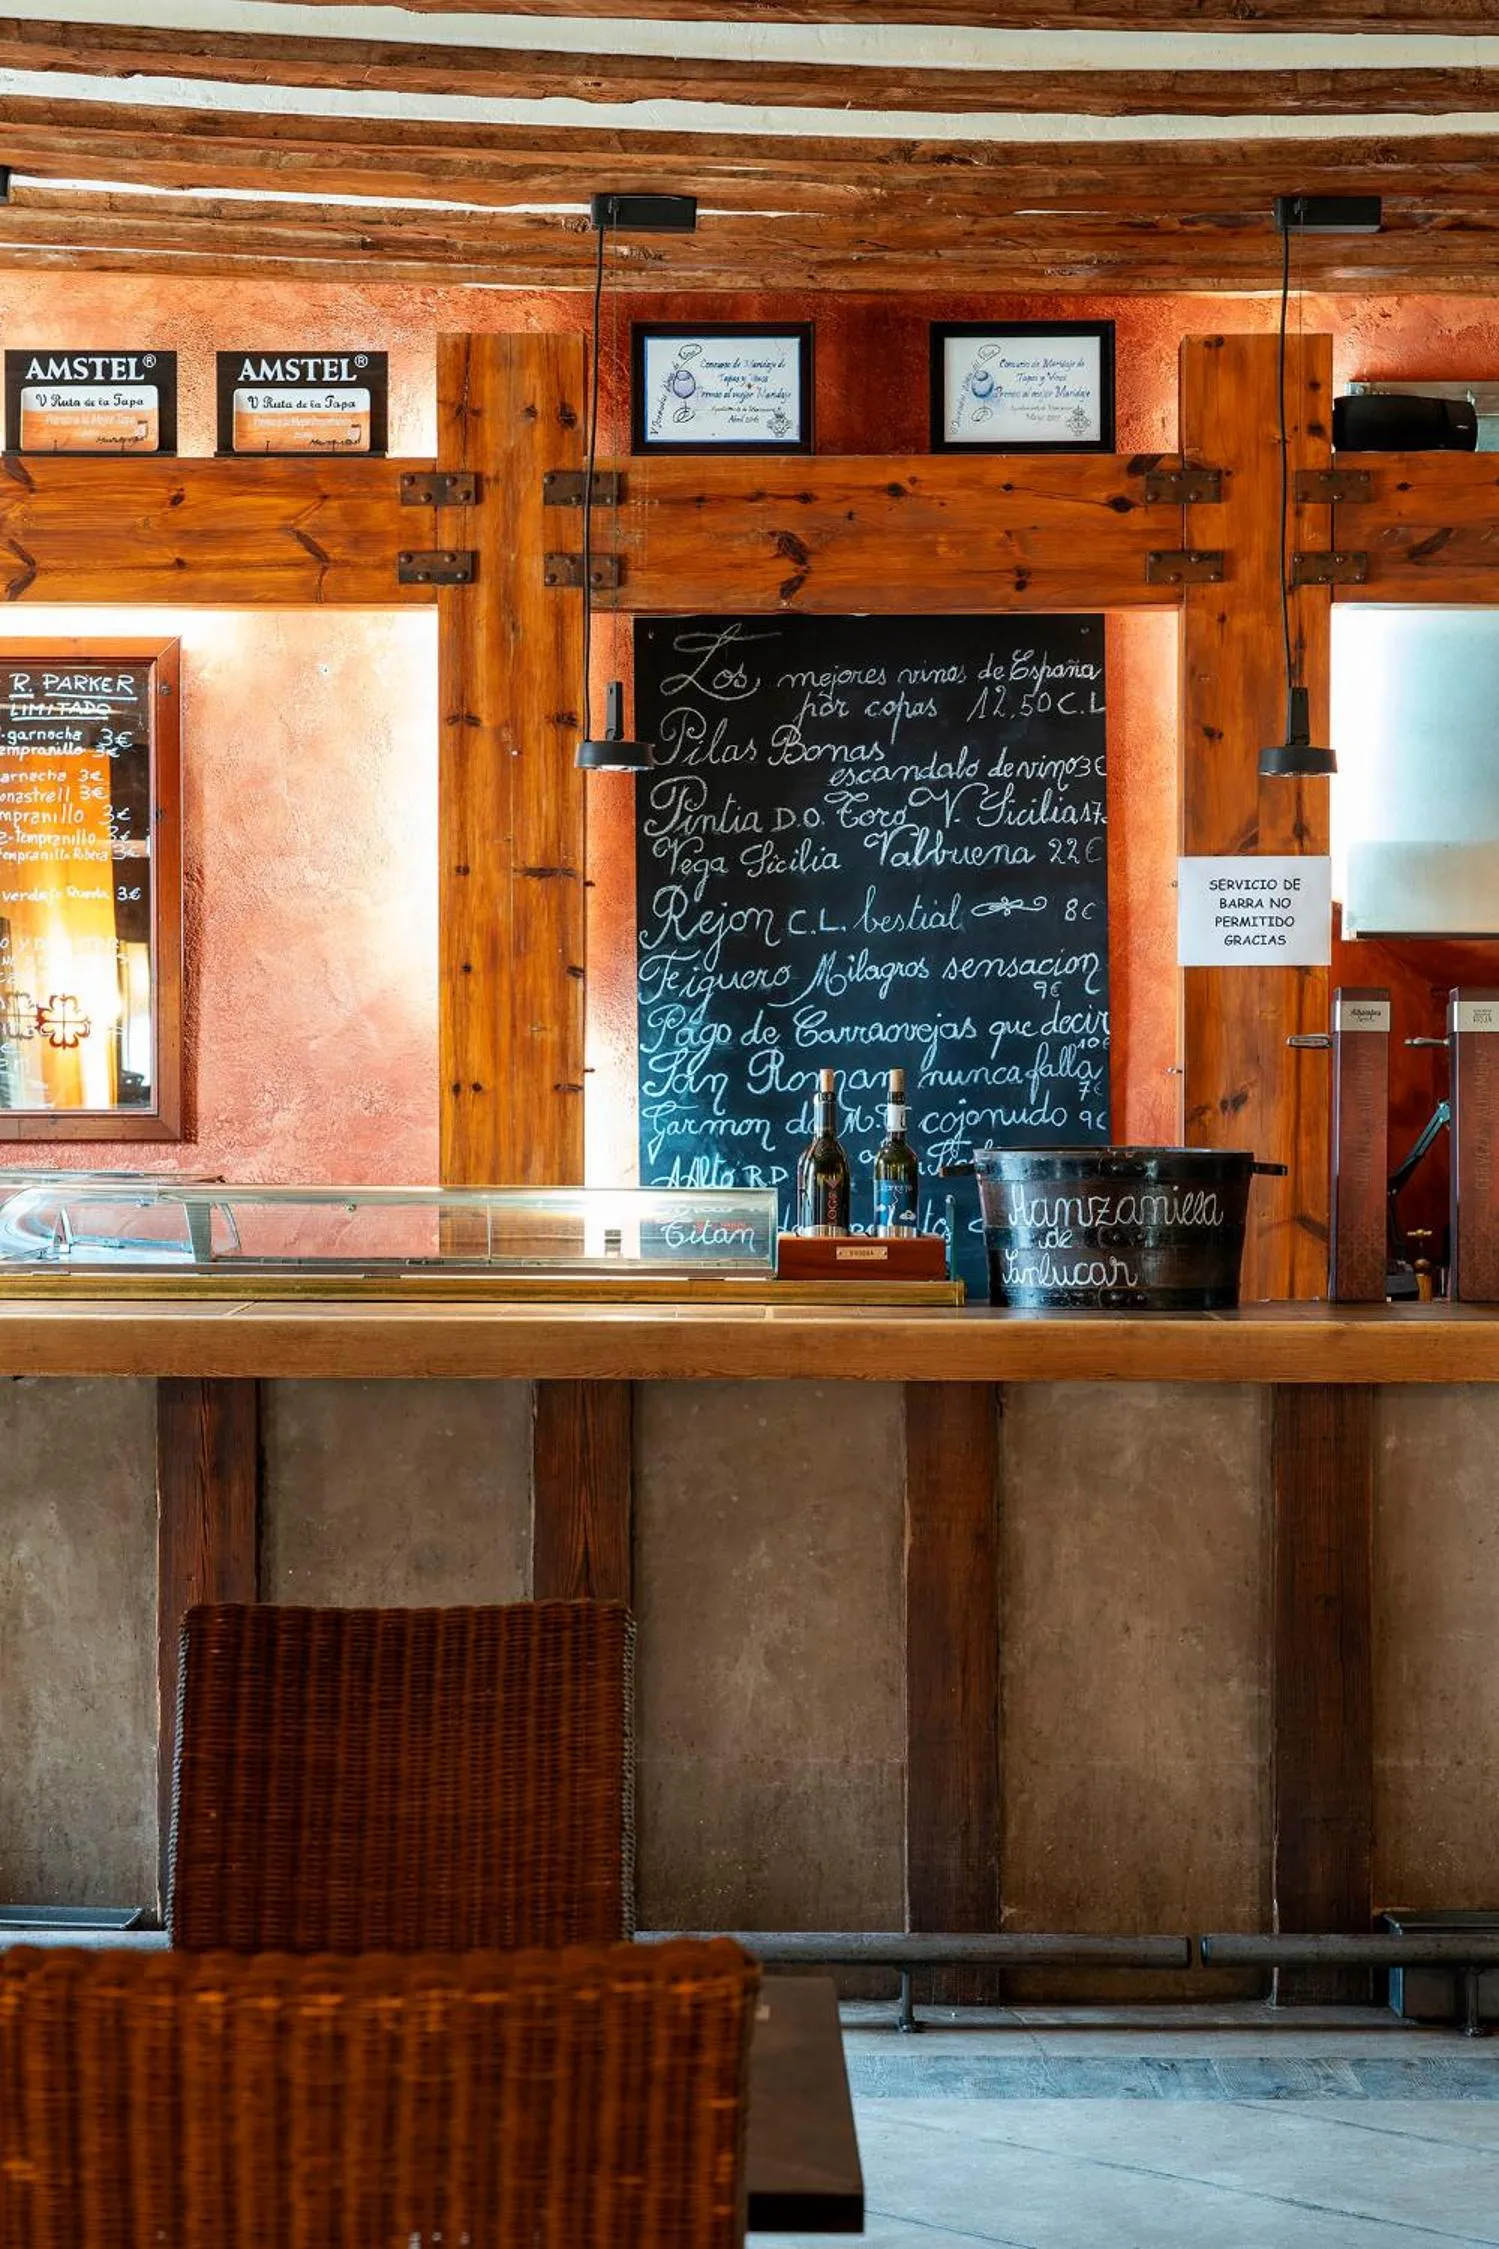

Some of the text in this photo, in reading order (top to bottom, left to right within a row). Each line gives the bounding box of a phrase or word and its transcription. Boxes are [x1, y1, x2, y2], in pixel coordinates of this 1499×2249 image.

[51, 393, 81, 408] Ruta
[84, 396, 96, 408] de
[98, 396, 110, 407] la
[113, 393, 144, 409] Tapa
[263, 396, 293, 410] Ruta
[296, 398, 308, 410] de
[310, 399, 322, 410] la
[325, 395, 356, 412] Tapa
[9, 672, 135, 695] R. PARKER
[777, 664, 888, 700] mejores
[897, 659, 968, 685] vinos
[978, 652, 1005, 681] de
[1009, 649, 1103, 698] España
[10, 700, 112, 717] LIMITADO
[792, 690, 849, 728] por
[864, 689, 938, 745] copas
[100, 728, 133, 749] 3€
[651, 706, 886, 767] Pilas Bonas
[92, 742, 121, 758] 3€
[79, 768, 105, 783] 3€
[830, 745, 979, 787] escandalo
[80, 784, 109, 800] 3€
[98, 804, 132, 825] 3€
[643, 775, 764, 837] Pintia
[824, 790, 907, 829] Toro
[977, 781, 1080, 827] Sicilia
[653, 835, 729, 903] Vega
[740, 837, 843, 878] Sicilia
[863, 823, 1037, 867] Valbuena
[117, 885, 142, 901] 3€
[1208, 878, 1301, 891] SERVICIO DE
[1219, 897, 1292, 909] BARRA NO
[639, 884, 782, 973] Rejon
[854, 884, 963, 934] bestial
[1214, 915, 1296, 928] PERMITIDO
[1223, 934, 1287, 946] GRACIAS
[767, 947, 931, 1008] Milagros
[942, 948, 1101, 995] sensacion
[639, 1000, 1109, 1076] Pago de Carraovejas que decir
[641, 1047, 729, 1116] San
[917, 1065, 1024, 1091] nunca
[1025, 1041, 1104, 1106] falla
[641, 1100, 776, 1166] Garmon
[917, 1088, 1068, 1147] cojonudo
[1007, 1182, 1225, 1228] Manzanilla
[1038, 1227, 1074, 1250] de
